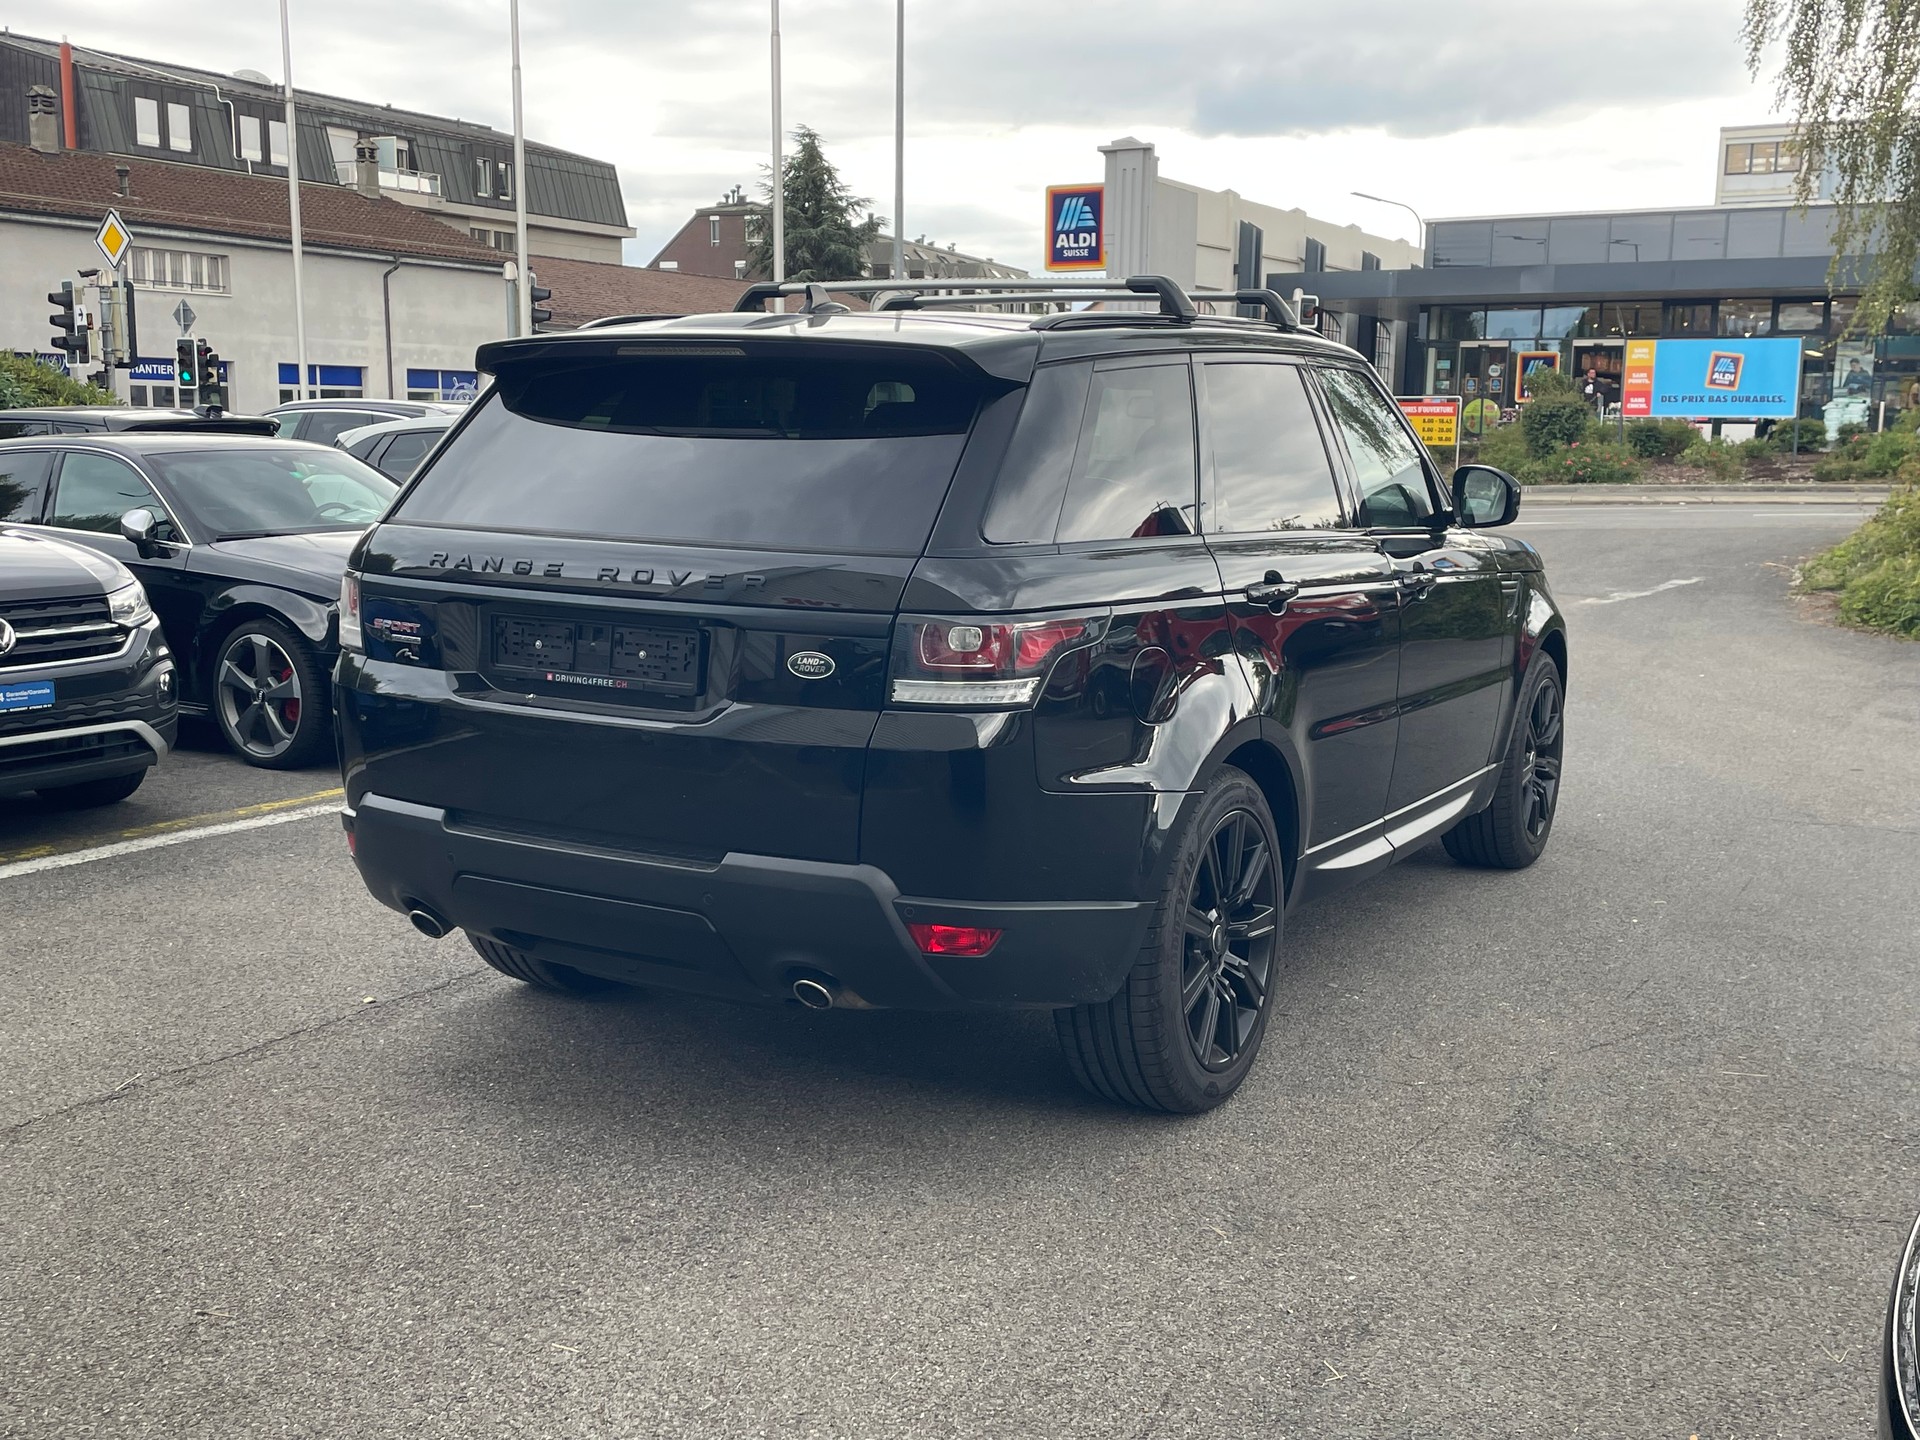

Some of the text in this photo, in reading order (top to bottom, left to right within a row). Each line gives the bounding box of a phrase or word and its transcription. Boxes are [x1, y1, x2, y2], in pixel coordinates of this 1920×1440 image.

[1056, 232, 1097, 248] ALDI
[1063, 249, 1089, 257] SUISSE
[129, 363, 174, 375] HANTIER
[1712, 372, 1735, 381] ALDI
[1661, 395, 1787, 403] DES PRIX BAS DURABLES.
[430, 551, 767, 592] RANGE ROVER
[374, 618, 421, 633] SPORT
[797, 657, 820, 665] LAND
[799, 664, 826, 673] ROVER
[555, 673, 628, 688] DRIVING4FREE.CH
